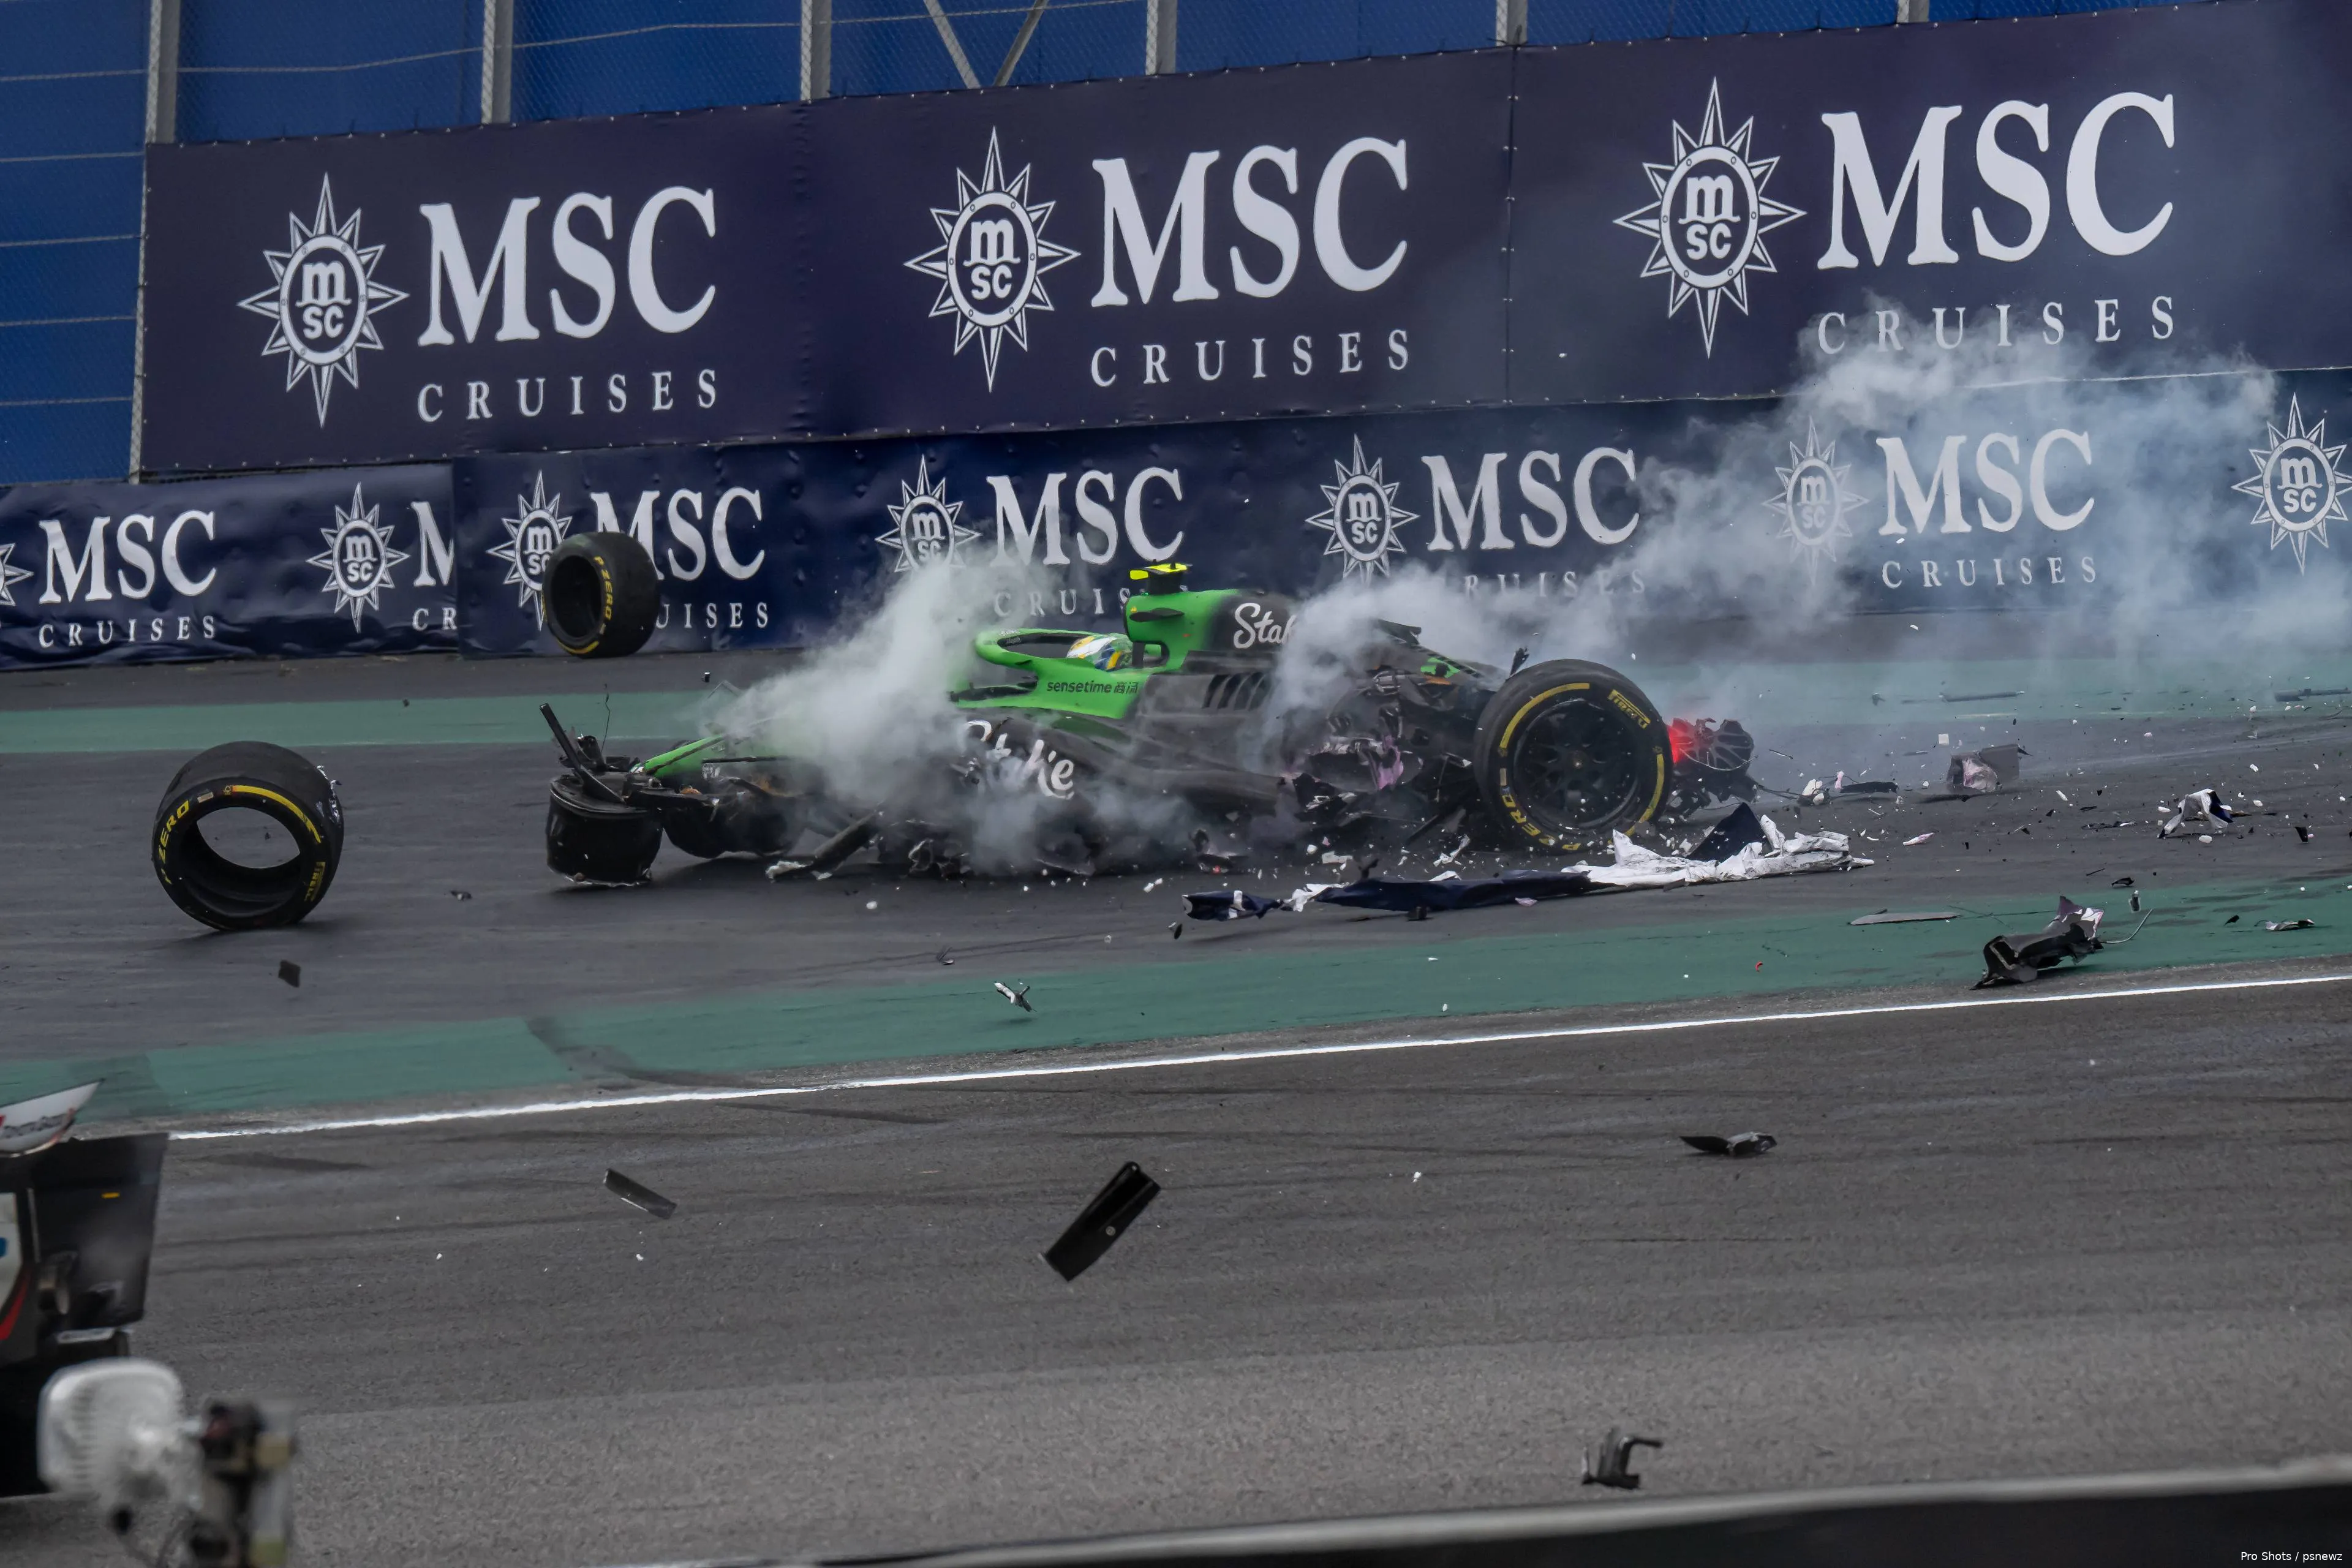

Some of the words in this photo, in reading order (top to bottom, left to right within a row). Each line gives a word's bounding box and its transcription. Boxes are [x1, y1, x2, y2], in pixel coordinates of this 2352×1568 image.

[1091, 137, 1408, 307] MSC
[1817, 91, 2174, 270] MSC
[418, 186, 715, 346] MSC
[1091, 329, 1409, 386] CRUISES
[1817, 295, 2174, 353] CRUISES
[418, 369, 716, 423] CRUISES
[986, 467, 1183, 567] MSC
[1421, 447, 1640, 552] MSC
[1875, 428, 2095, 535] MSC
[39, 510, 217, 604] MSC
[1882, 555, 2096, 588] CRUISES
[39, 615, 216, 649] CRUISES
[1047, 680, 1112, 693] sensetime
